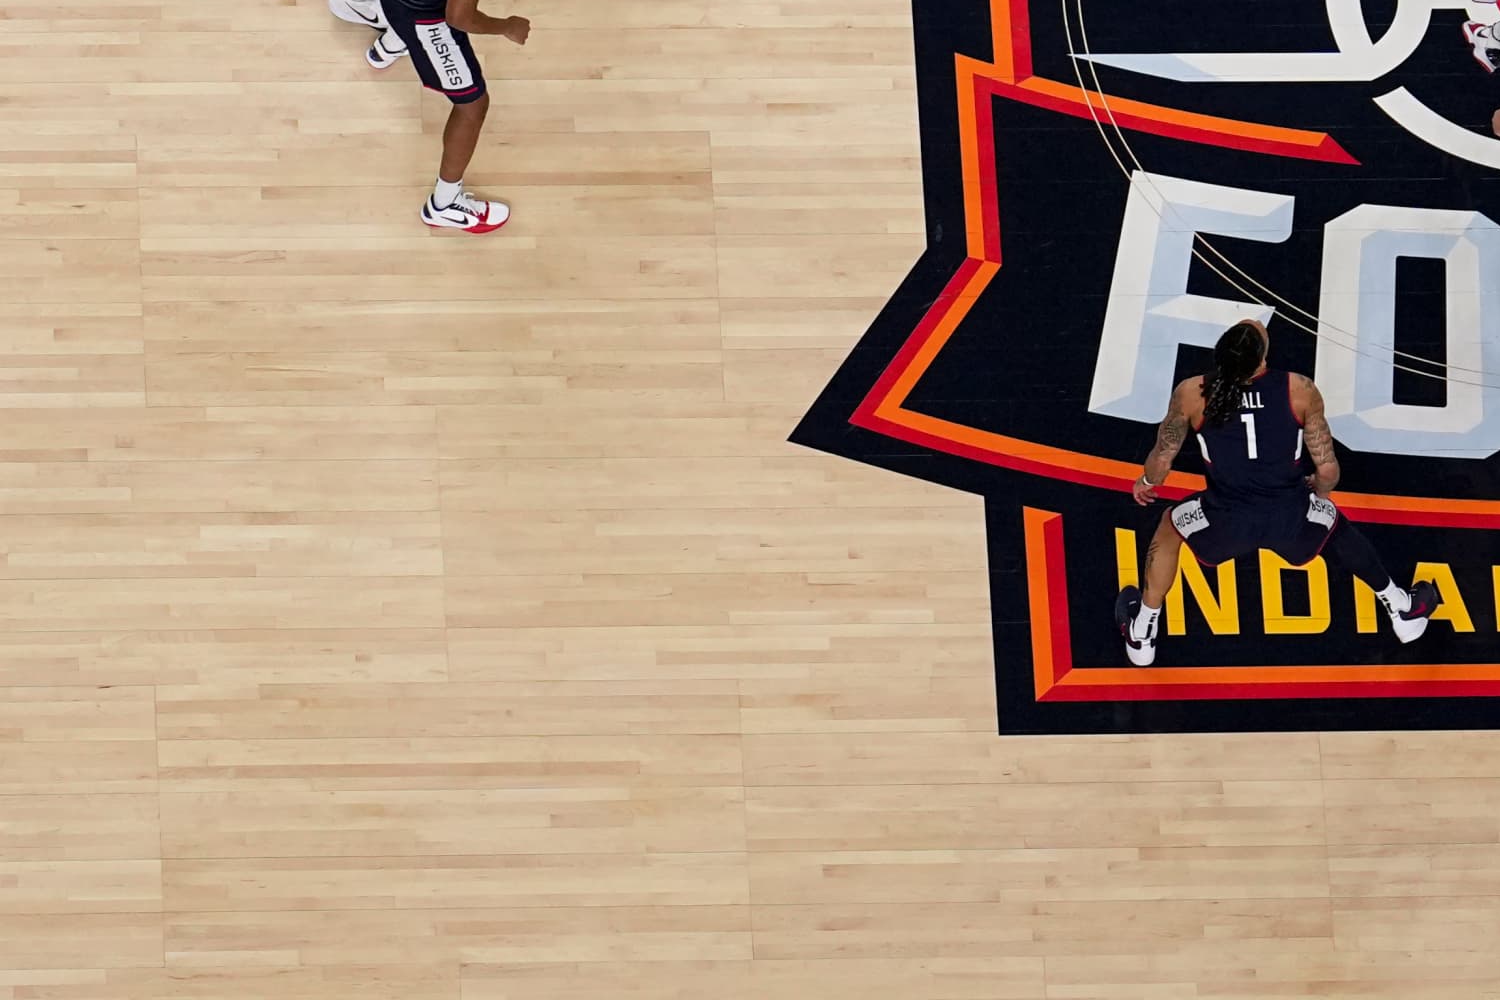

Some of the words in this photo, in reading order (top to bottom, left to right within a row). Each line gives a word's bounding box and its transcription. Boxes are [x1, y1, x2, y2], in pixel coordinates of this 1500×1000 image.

[427, 27, 463, 86] HUSKIES
[1238, 391, 1265, 409] ALL
[1240, 413, 1259, 459] 1
